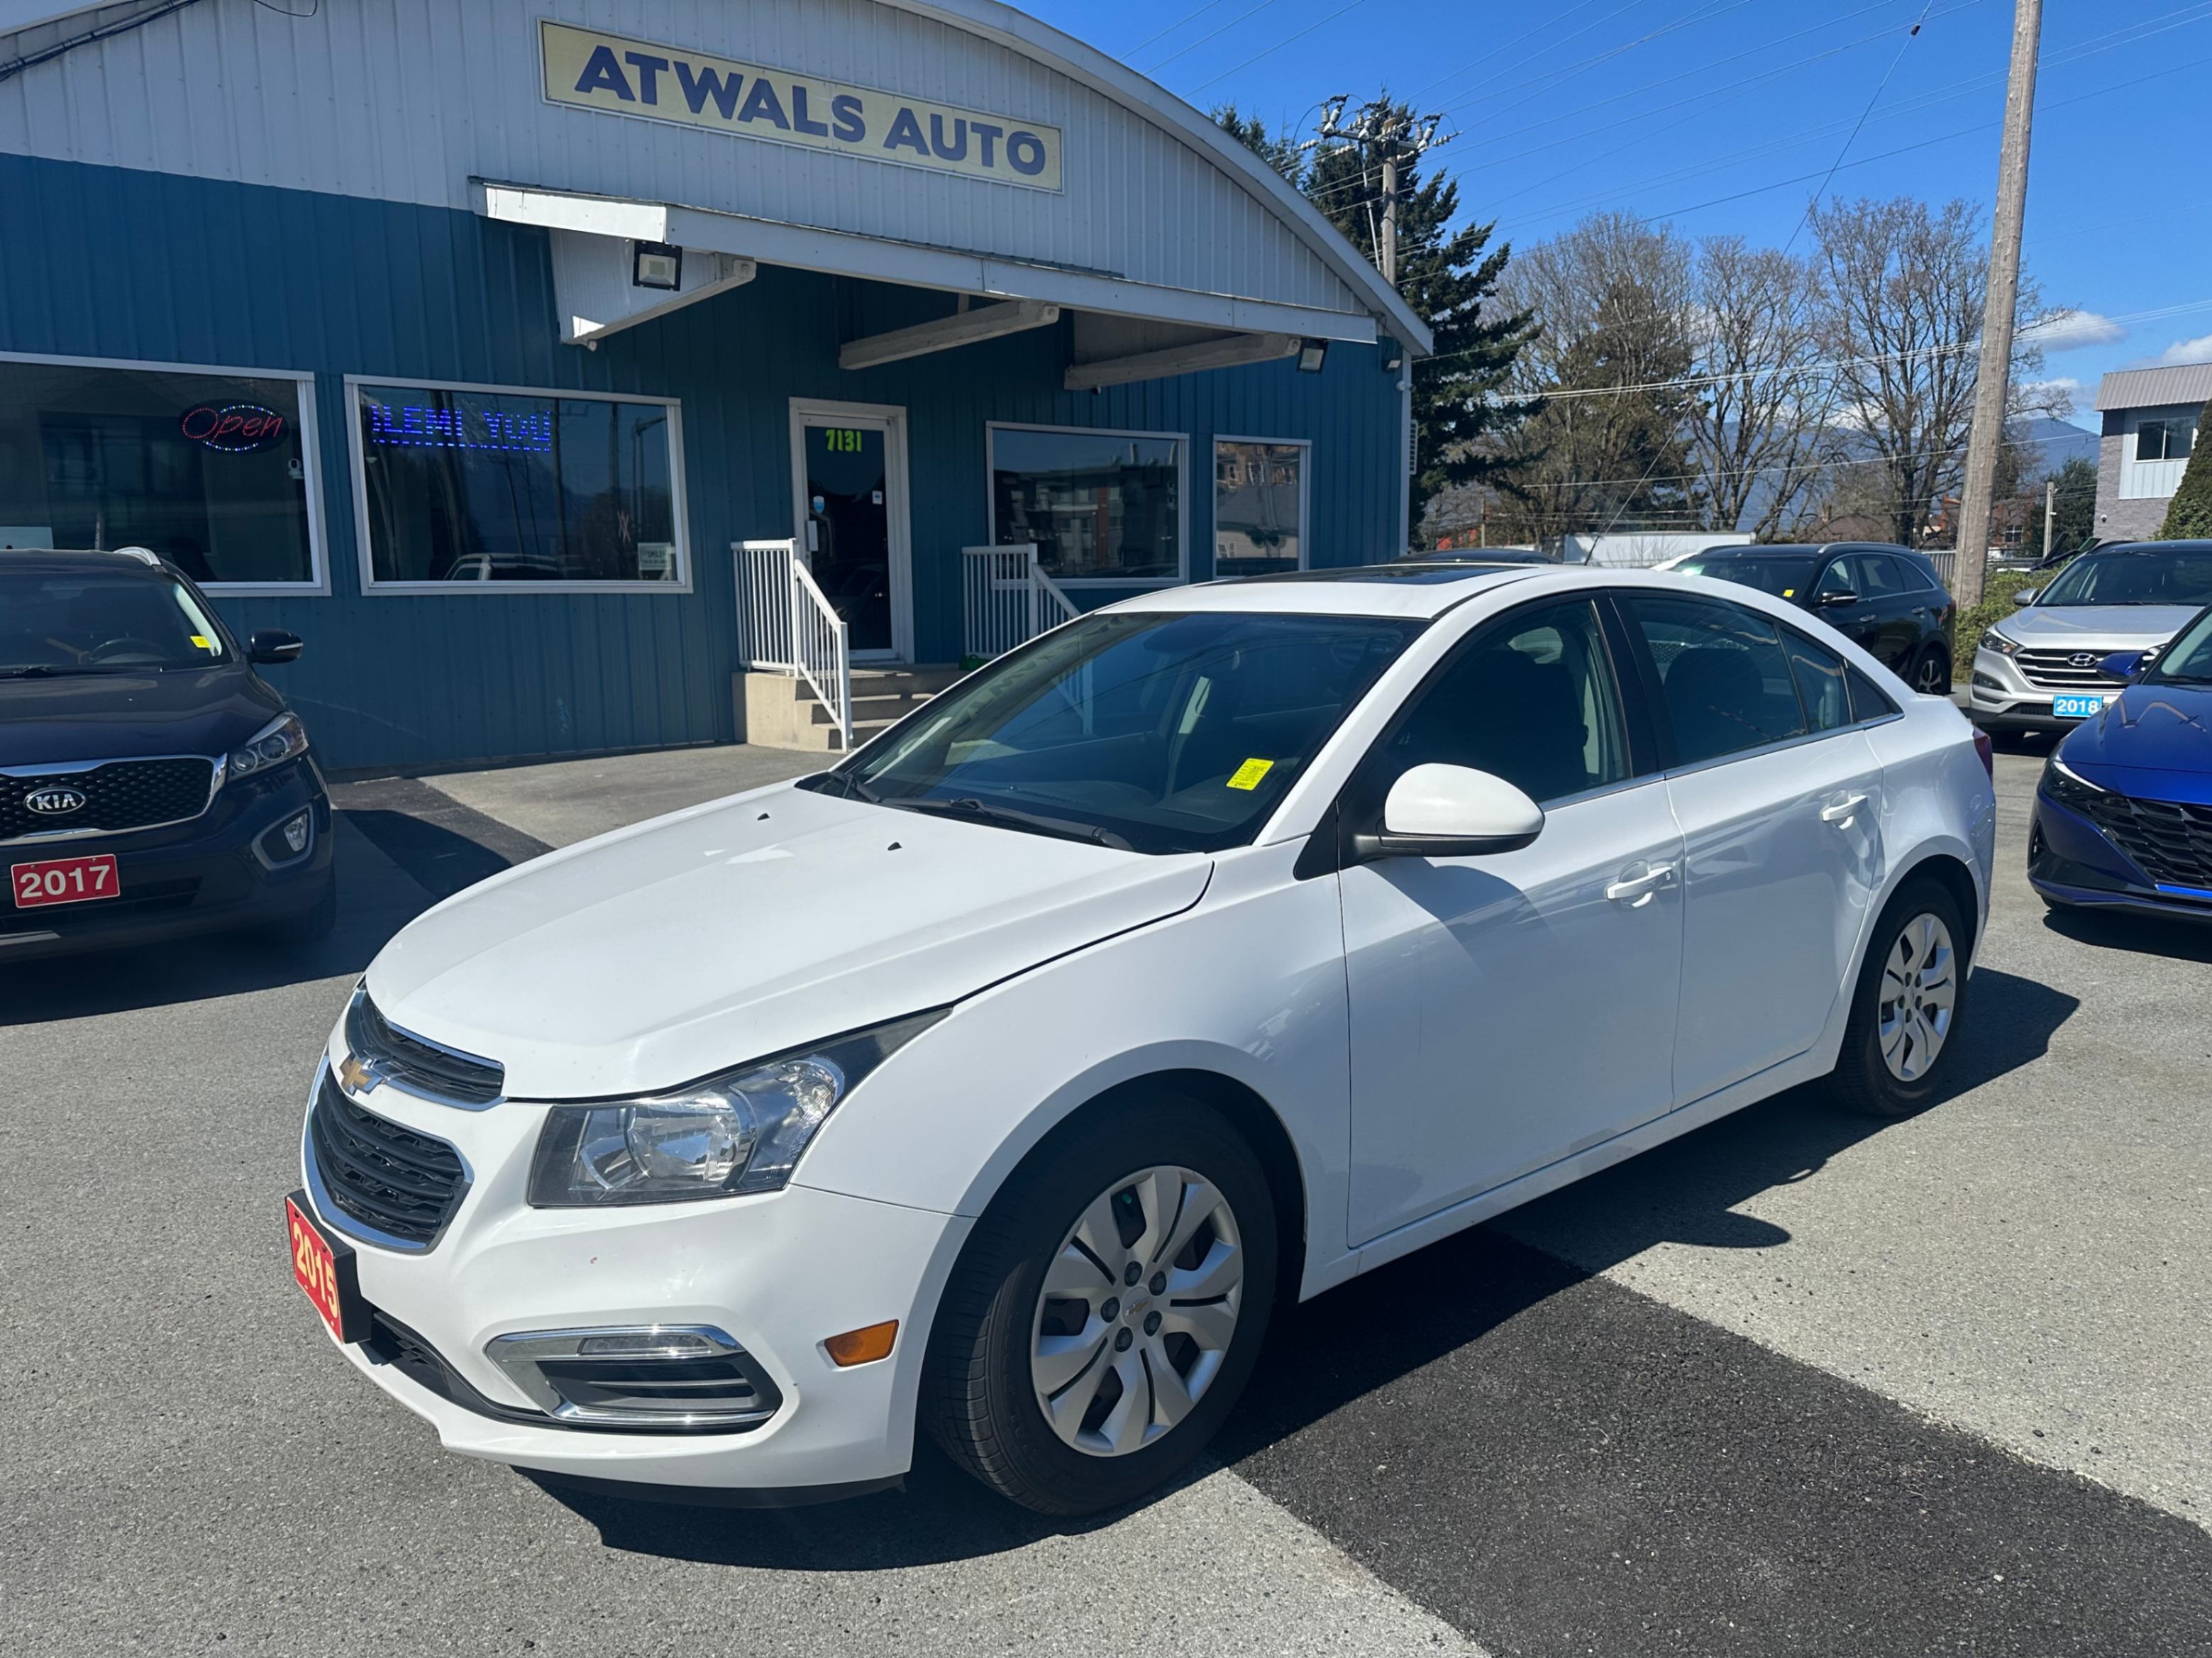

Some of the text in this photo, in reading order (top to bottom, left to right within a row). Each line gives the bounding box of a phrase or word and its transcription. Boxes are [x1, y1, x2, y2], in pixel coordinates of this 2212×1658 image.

[575, 45, 1046, 175] ATWALS AUTO
[182, 407, 283, 443] Open
[826, 429, 863, 452] 7131
[2057, 699, 2099, 714] 2018
[36, 793, 77, 810] KIA
[20, 865, 110, 899] 2017
[293, 1221, 338, 1319] 2015
